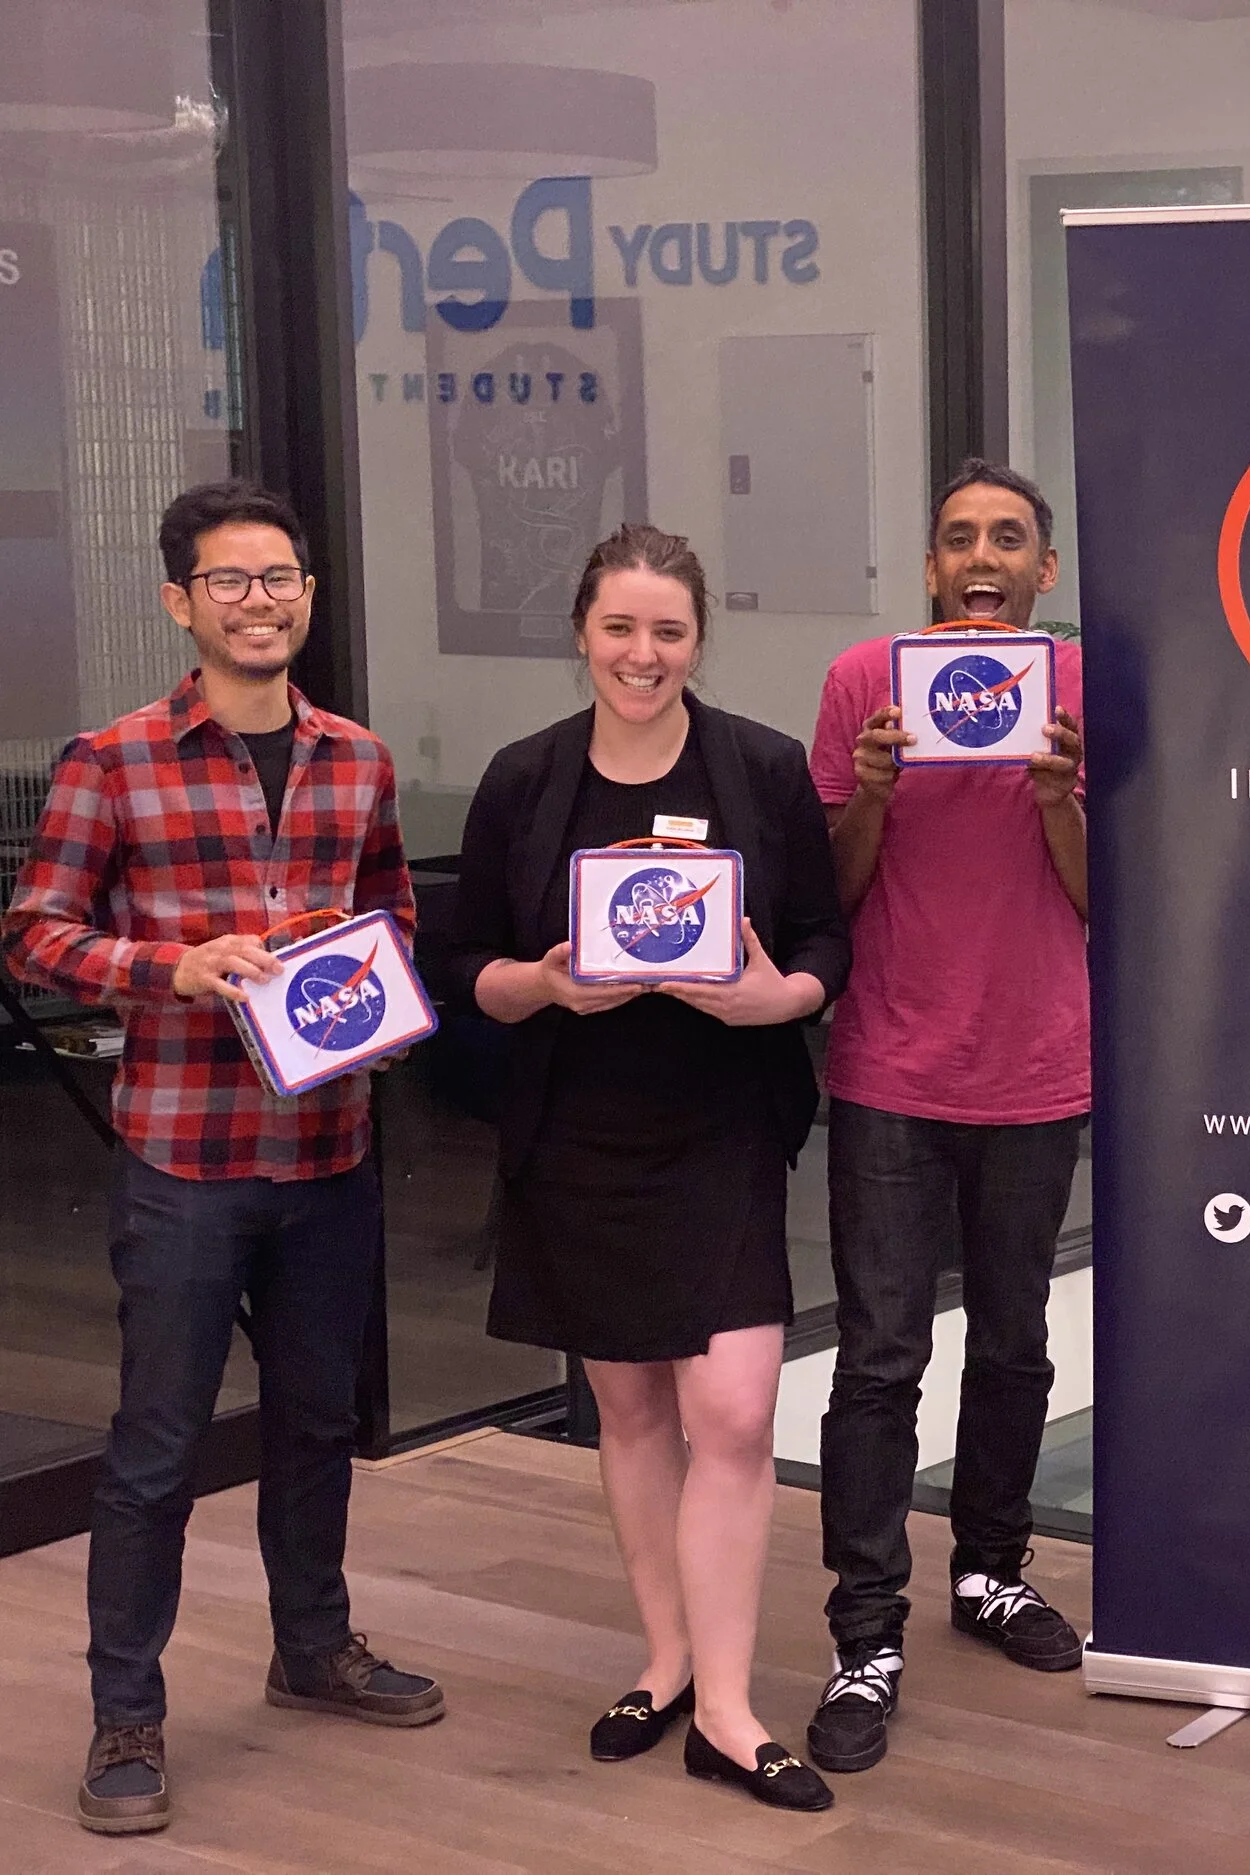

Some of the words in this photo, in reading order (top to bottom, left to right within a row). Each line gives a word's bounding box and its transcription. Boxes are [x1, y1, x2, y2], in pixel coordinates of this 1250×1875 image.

[498, 454, 579, 489] KARI
[934, 691, 1018, 712] NASA
[616, 904, 701, 926] NASA
[293, 978, 381, 1029] NASA
